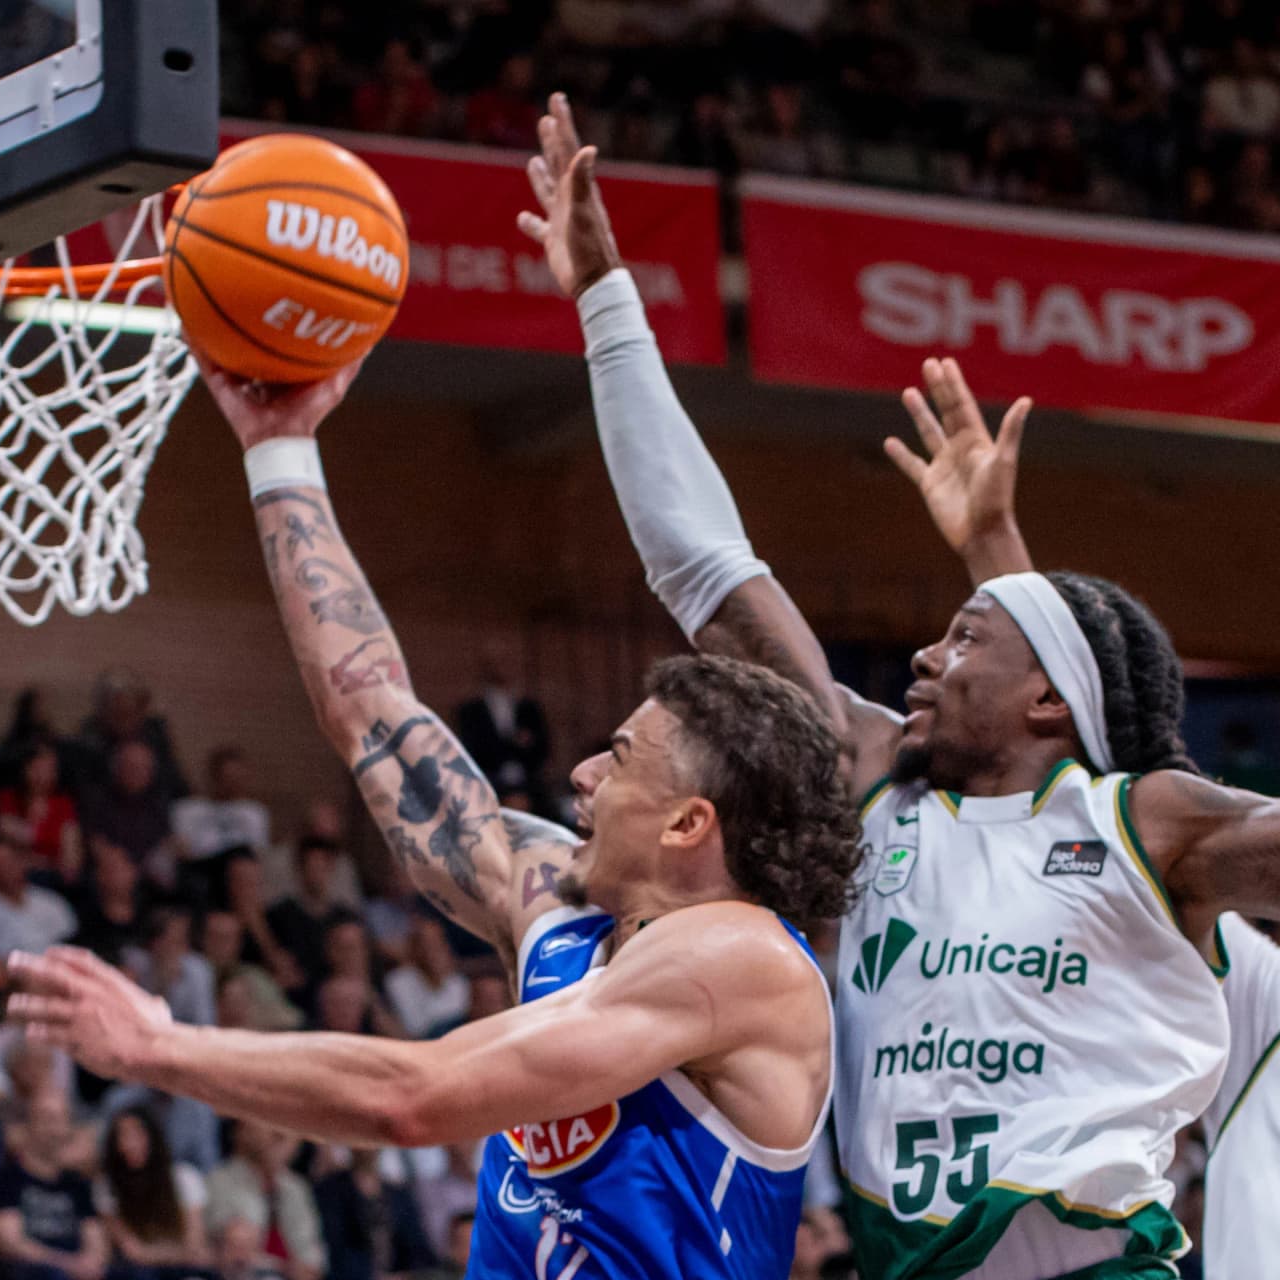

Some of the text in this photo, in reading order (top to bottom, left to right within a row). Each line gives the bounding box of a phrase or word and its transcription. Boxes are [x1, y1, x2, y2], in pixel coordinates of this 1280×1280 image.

[265, 199, 402, 292] Wilson
[856, 261, 1254, 372] SHARP
[919, 933, 1089, 993] Unicaja
[891, 1113, 1000, 1217] 55
